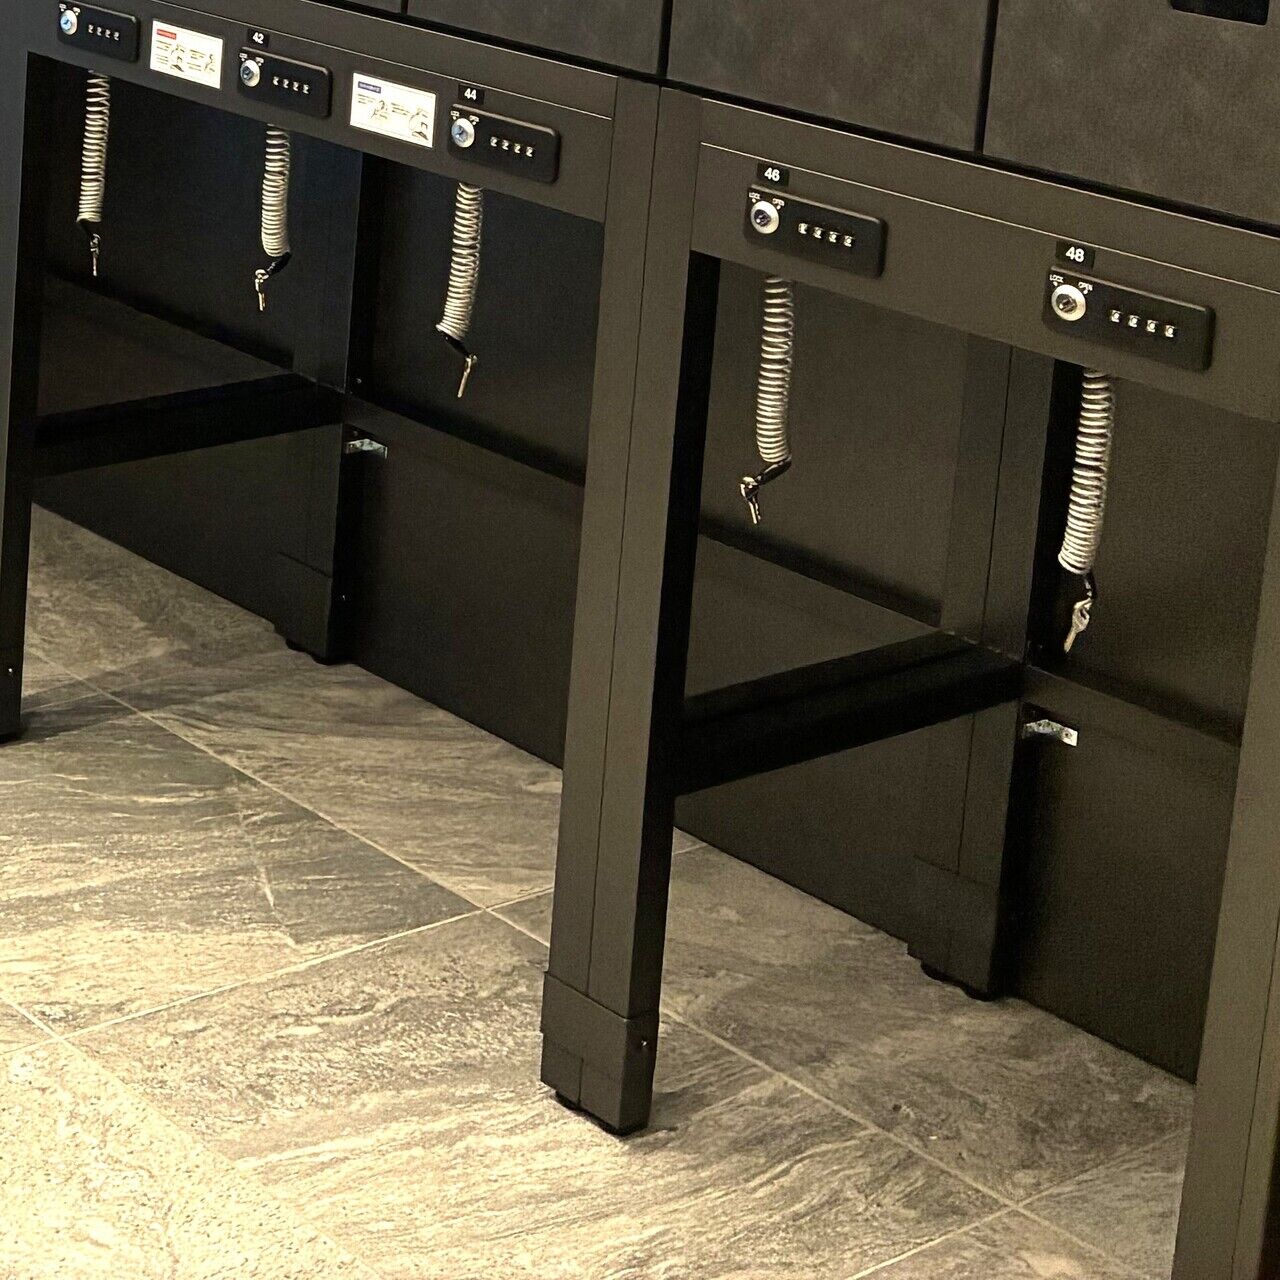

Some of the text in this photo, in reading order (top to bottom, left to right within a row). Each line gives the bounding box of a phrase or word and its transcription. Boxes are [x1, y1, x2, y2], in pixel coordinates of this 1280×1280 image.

[252, 32, 264, 44] 42
[464, 88, 477, 101] 44
[1065, 246, 1085, 263] 48
